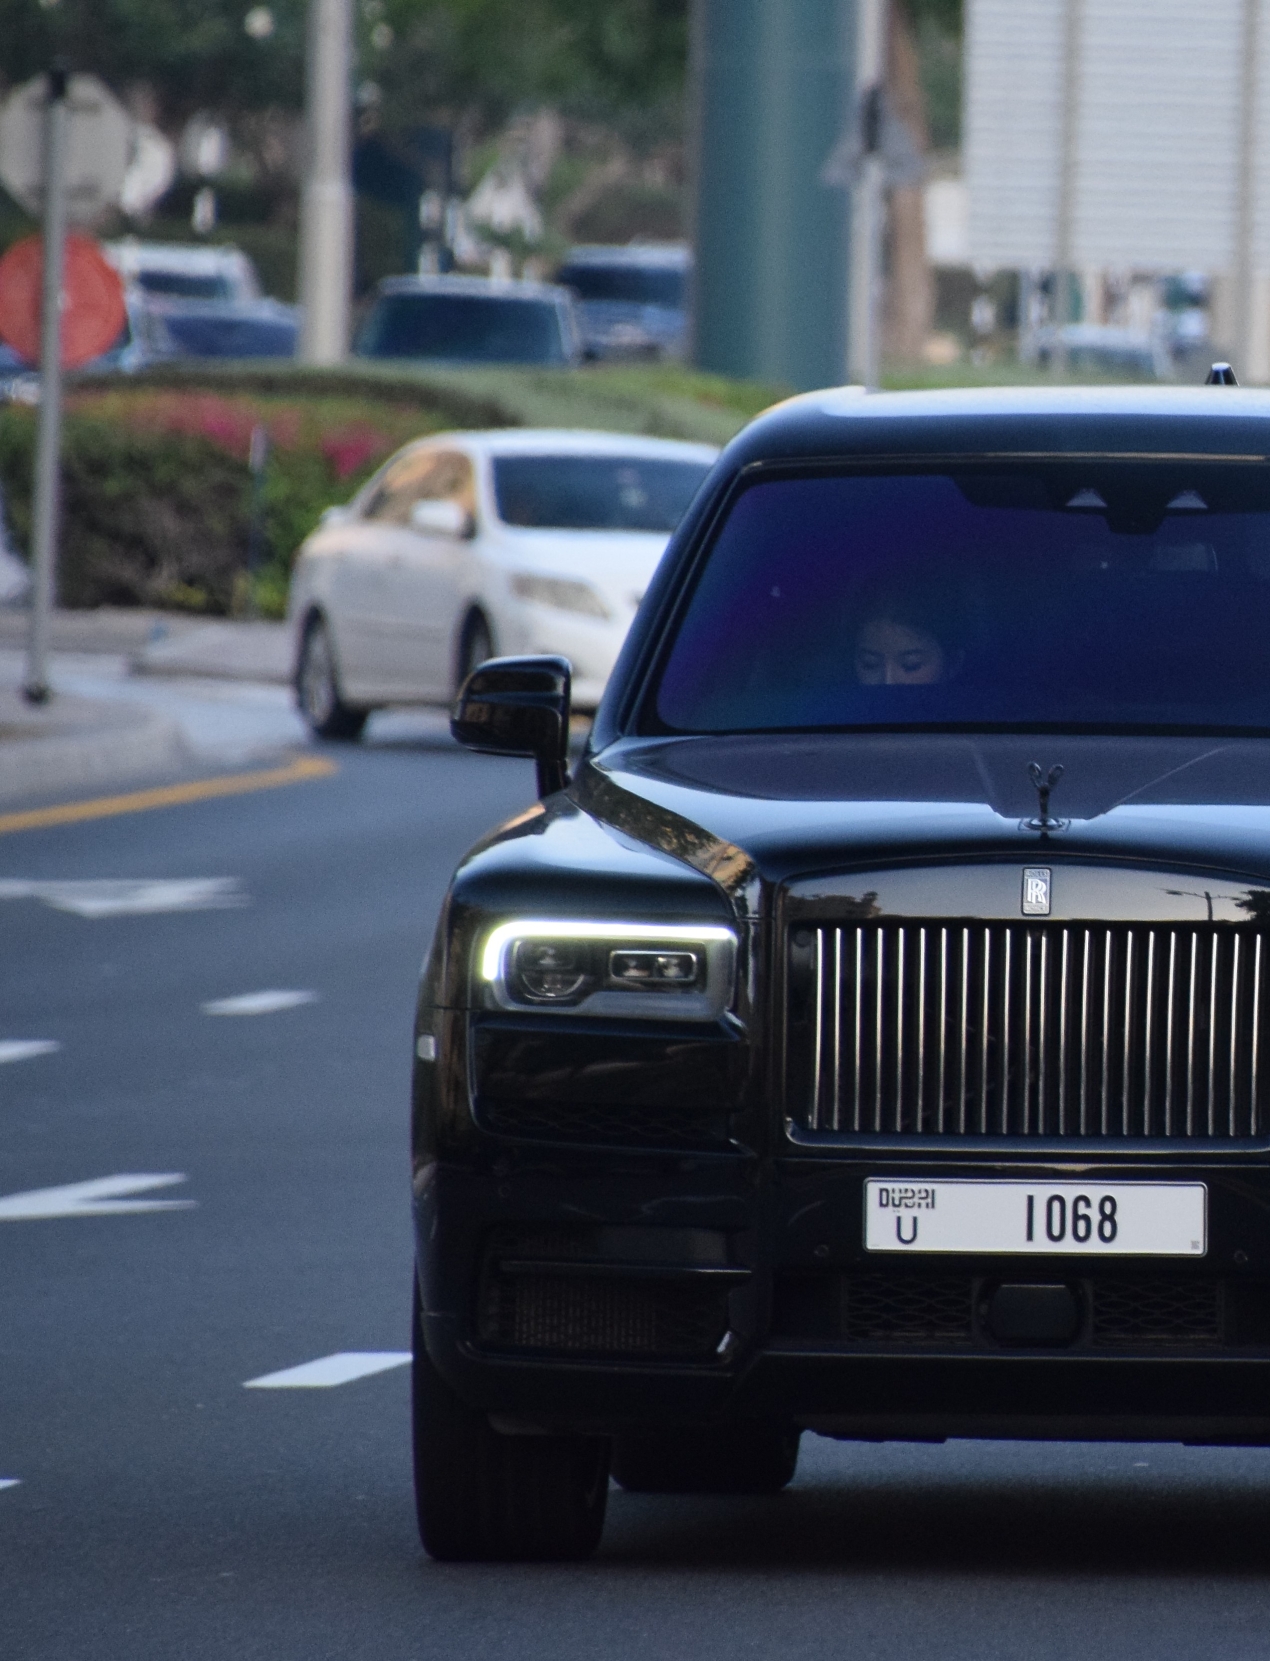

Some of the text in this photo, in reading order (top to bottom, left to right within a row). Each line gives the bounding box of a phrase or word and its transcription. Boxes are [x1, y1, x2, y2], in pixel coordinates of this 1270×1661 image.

[879, 1187, 935, 1209] DUBAI
[896, 1215, 918, 1246] U
[1025, 1194, 1118, 1244] 1068
